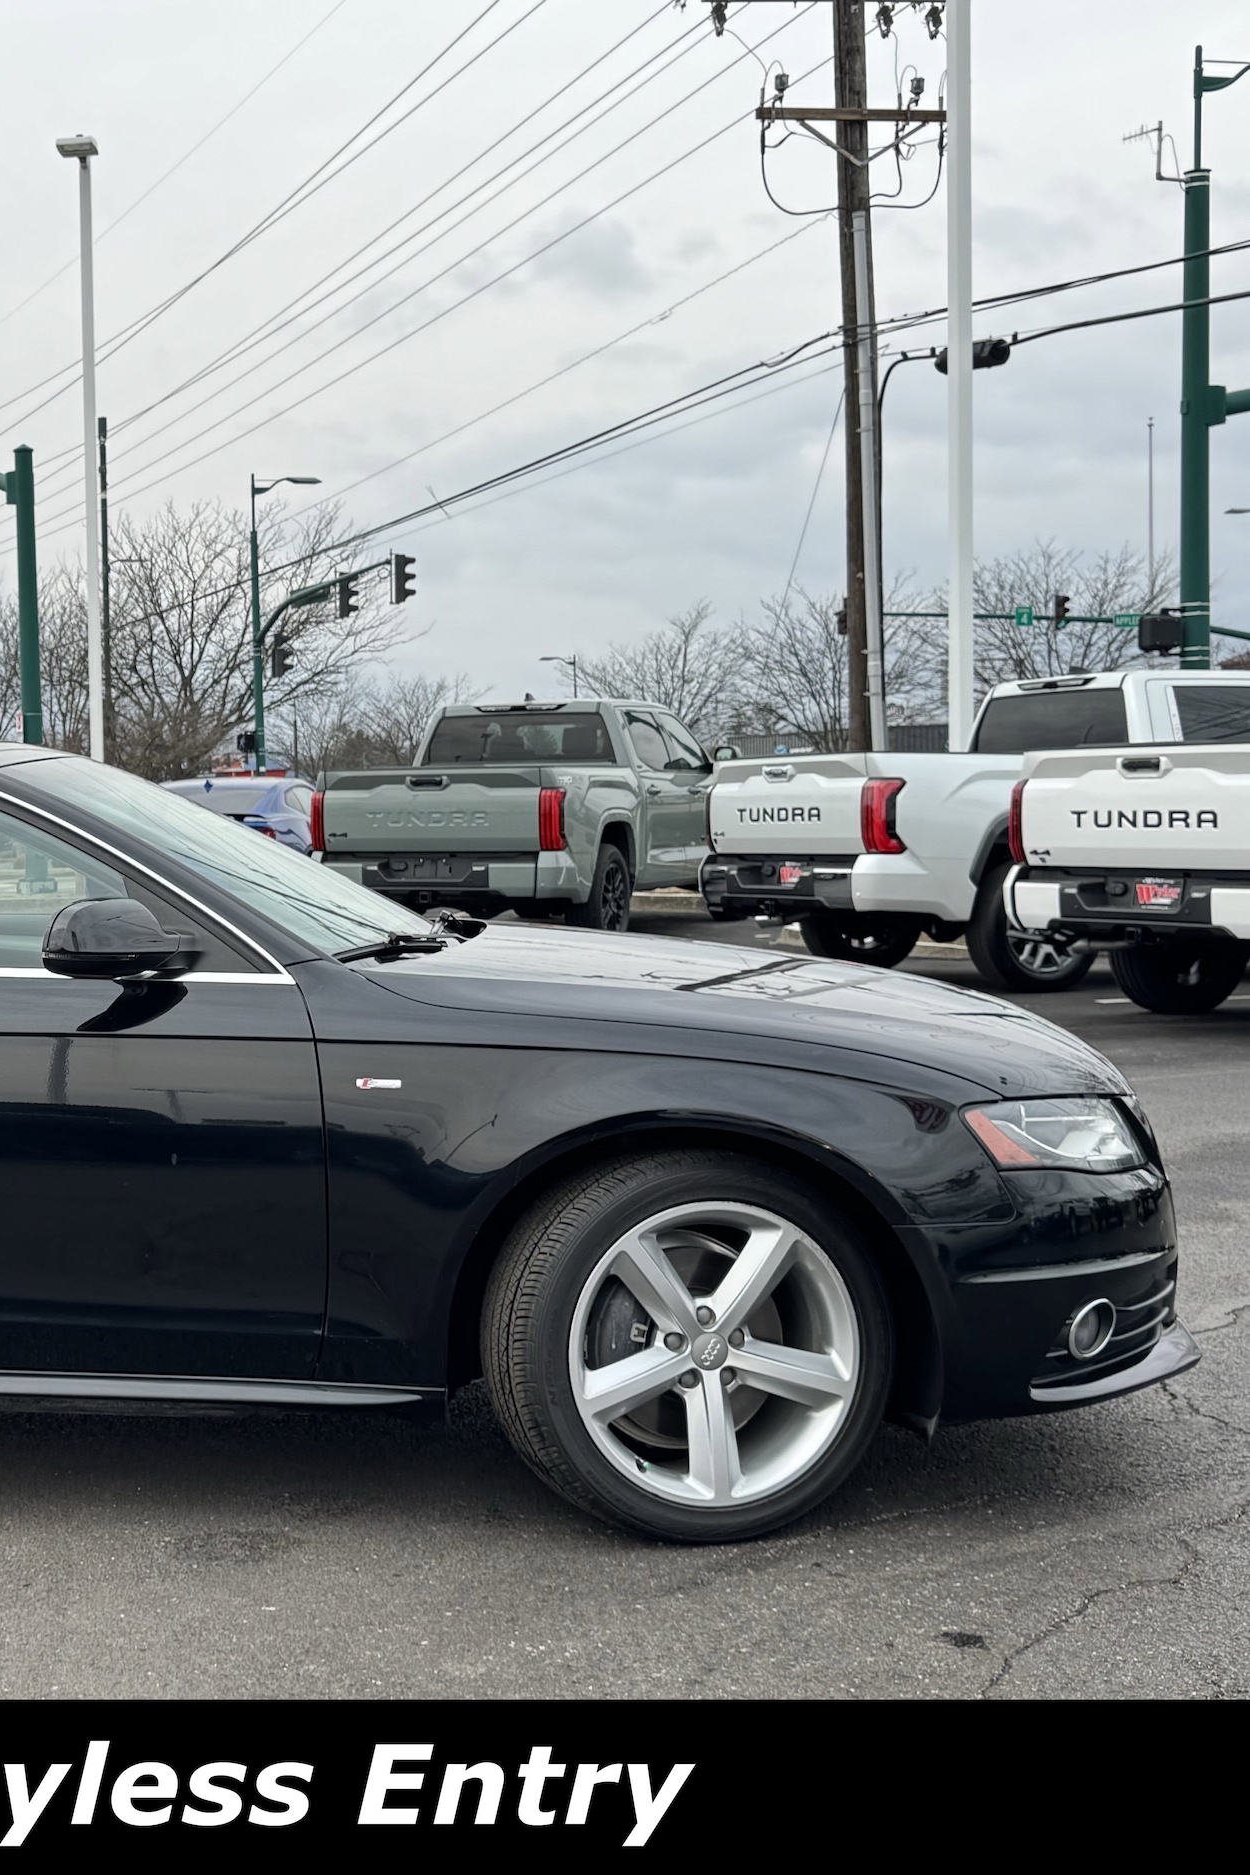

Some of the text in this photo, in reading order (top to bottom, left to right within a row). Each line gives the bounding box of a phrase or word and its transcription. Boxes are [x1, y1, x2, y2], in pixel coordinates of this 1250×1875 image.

[366, 811, 490, 828] TUNDRA
[736, 806, 822, 823] TUNDRA
[1070, 810, 1219, 829] TUNDRA
